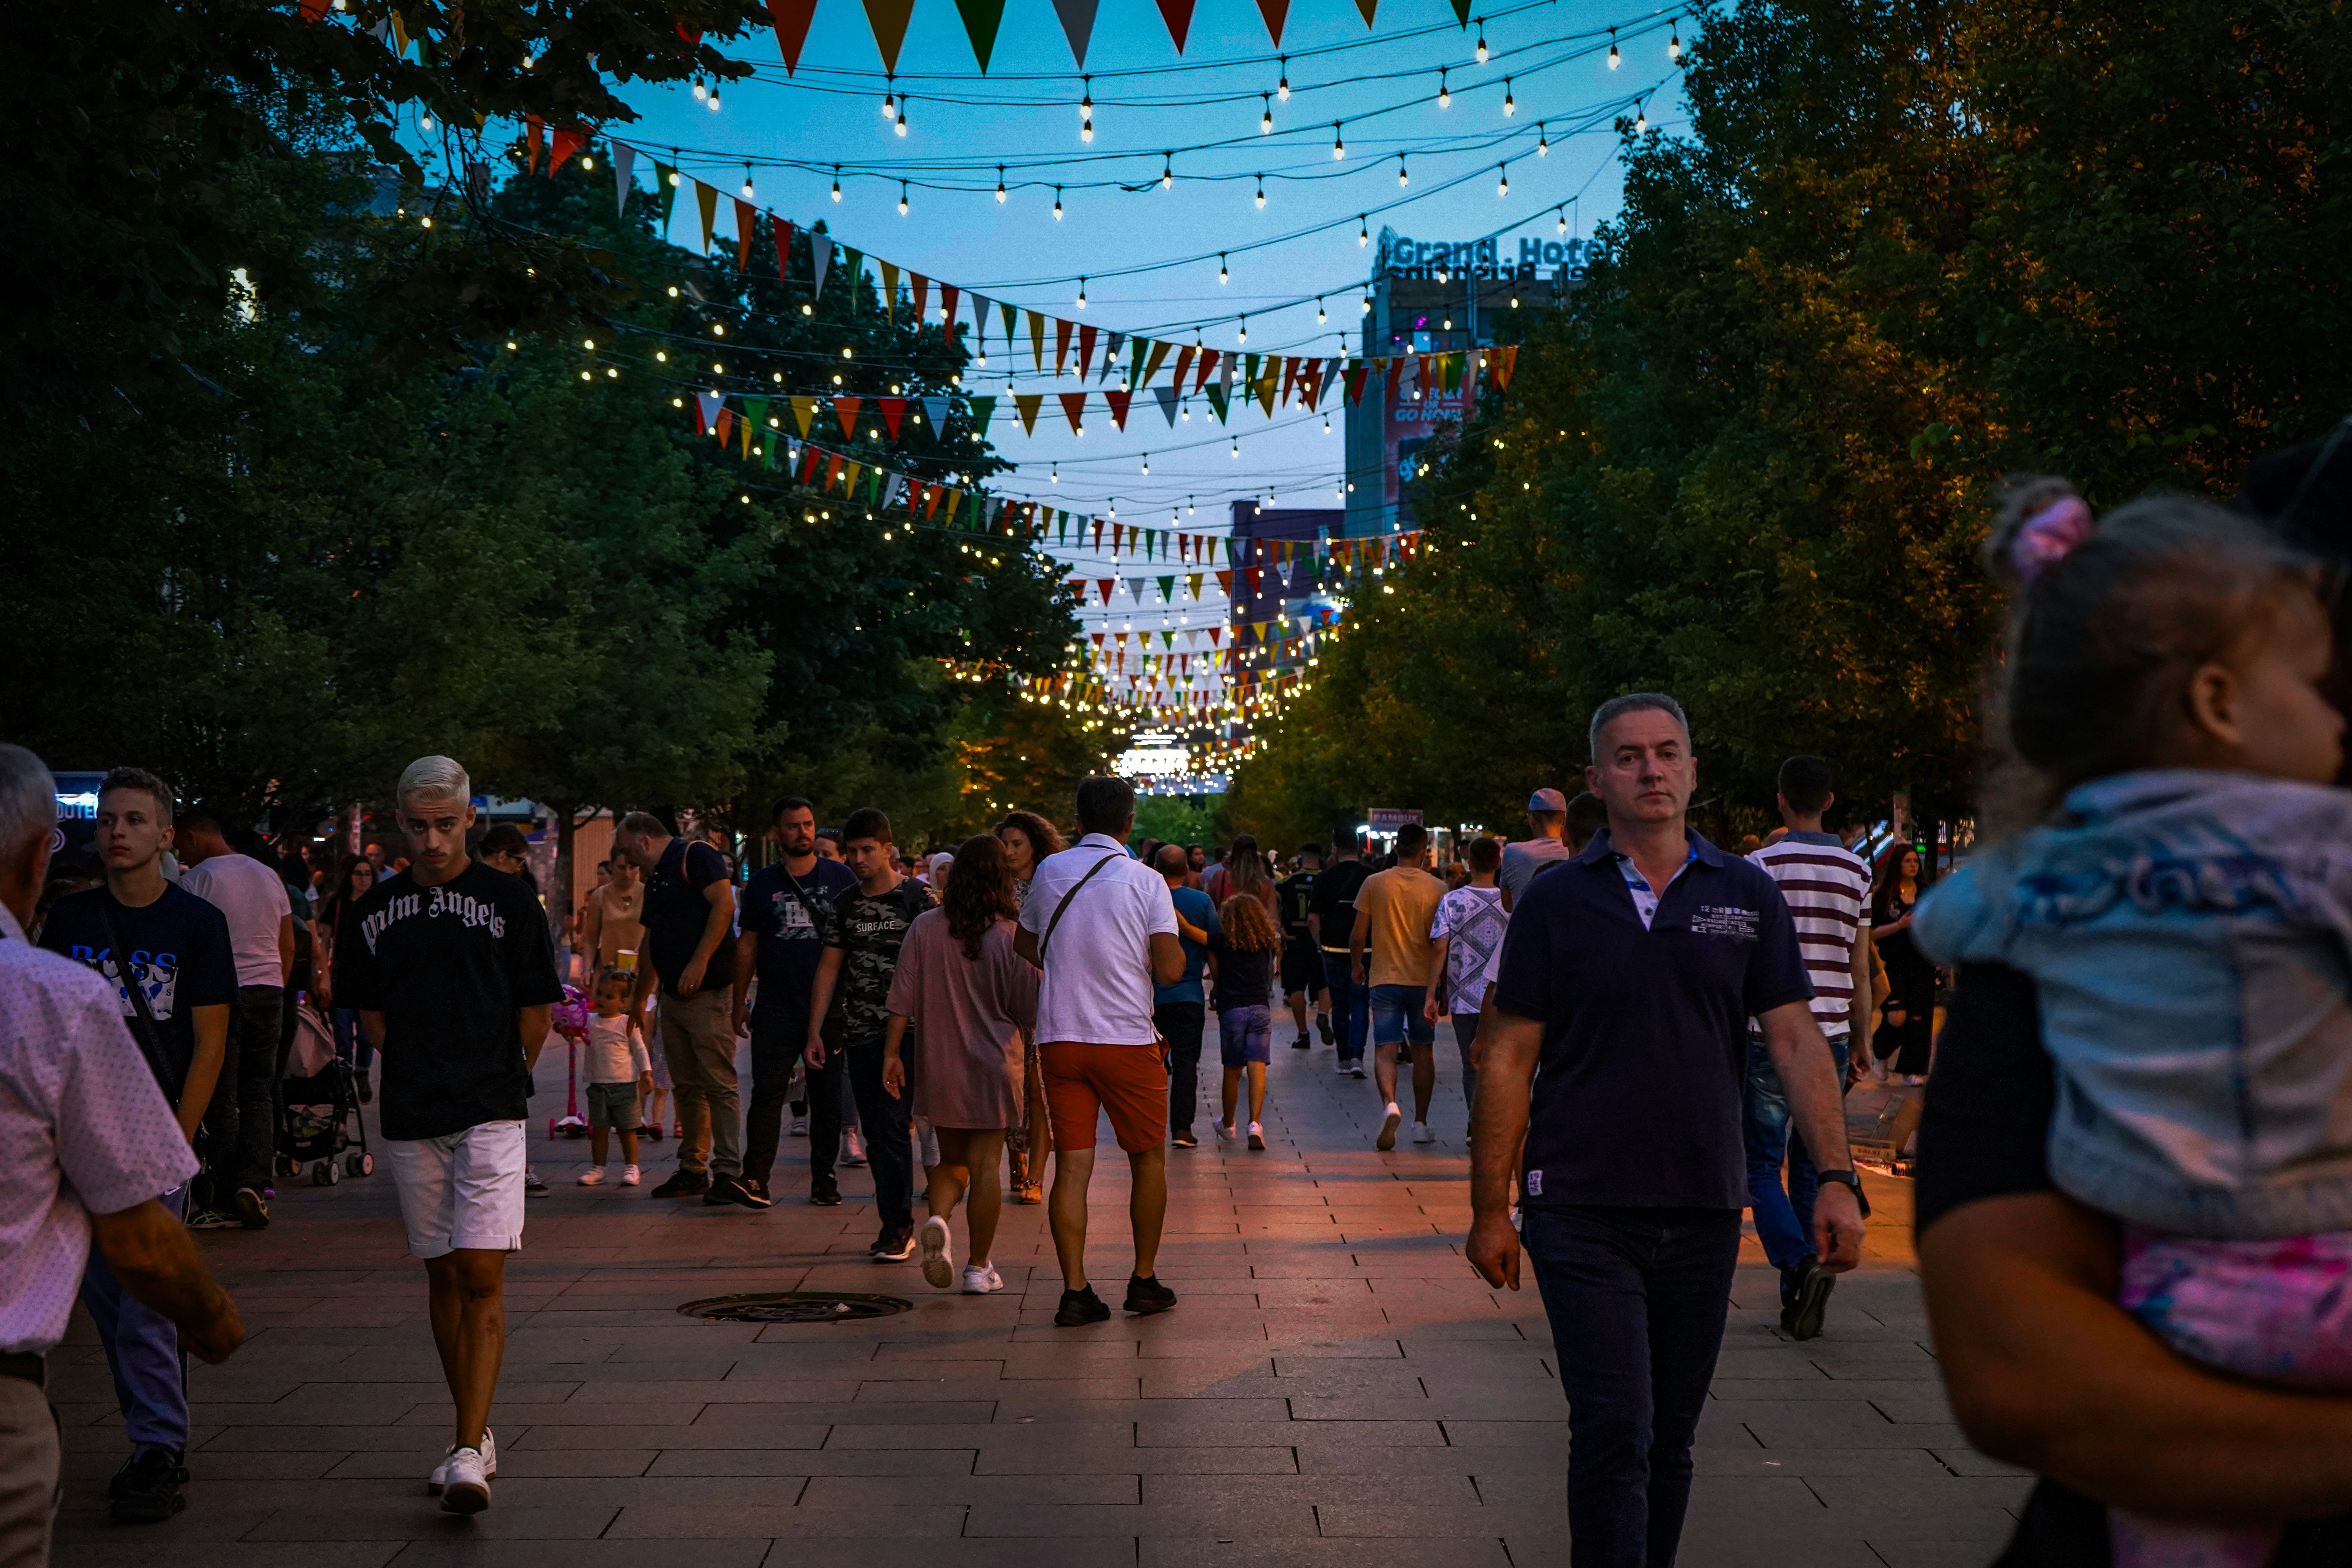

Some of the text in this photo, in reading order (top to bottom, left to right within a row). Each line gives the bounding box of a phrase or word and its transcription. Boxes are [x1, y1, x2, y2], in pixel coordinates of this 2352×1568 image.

[1394, 238, 1610, 264] Grand Hote
[428, 886, 506, 939] Angels
[857, 921, 895, 933] SURFACE
